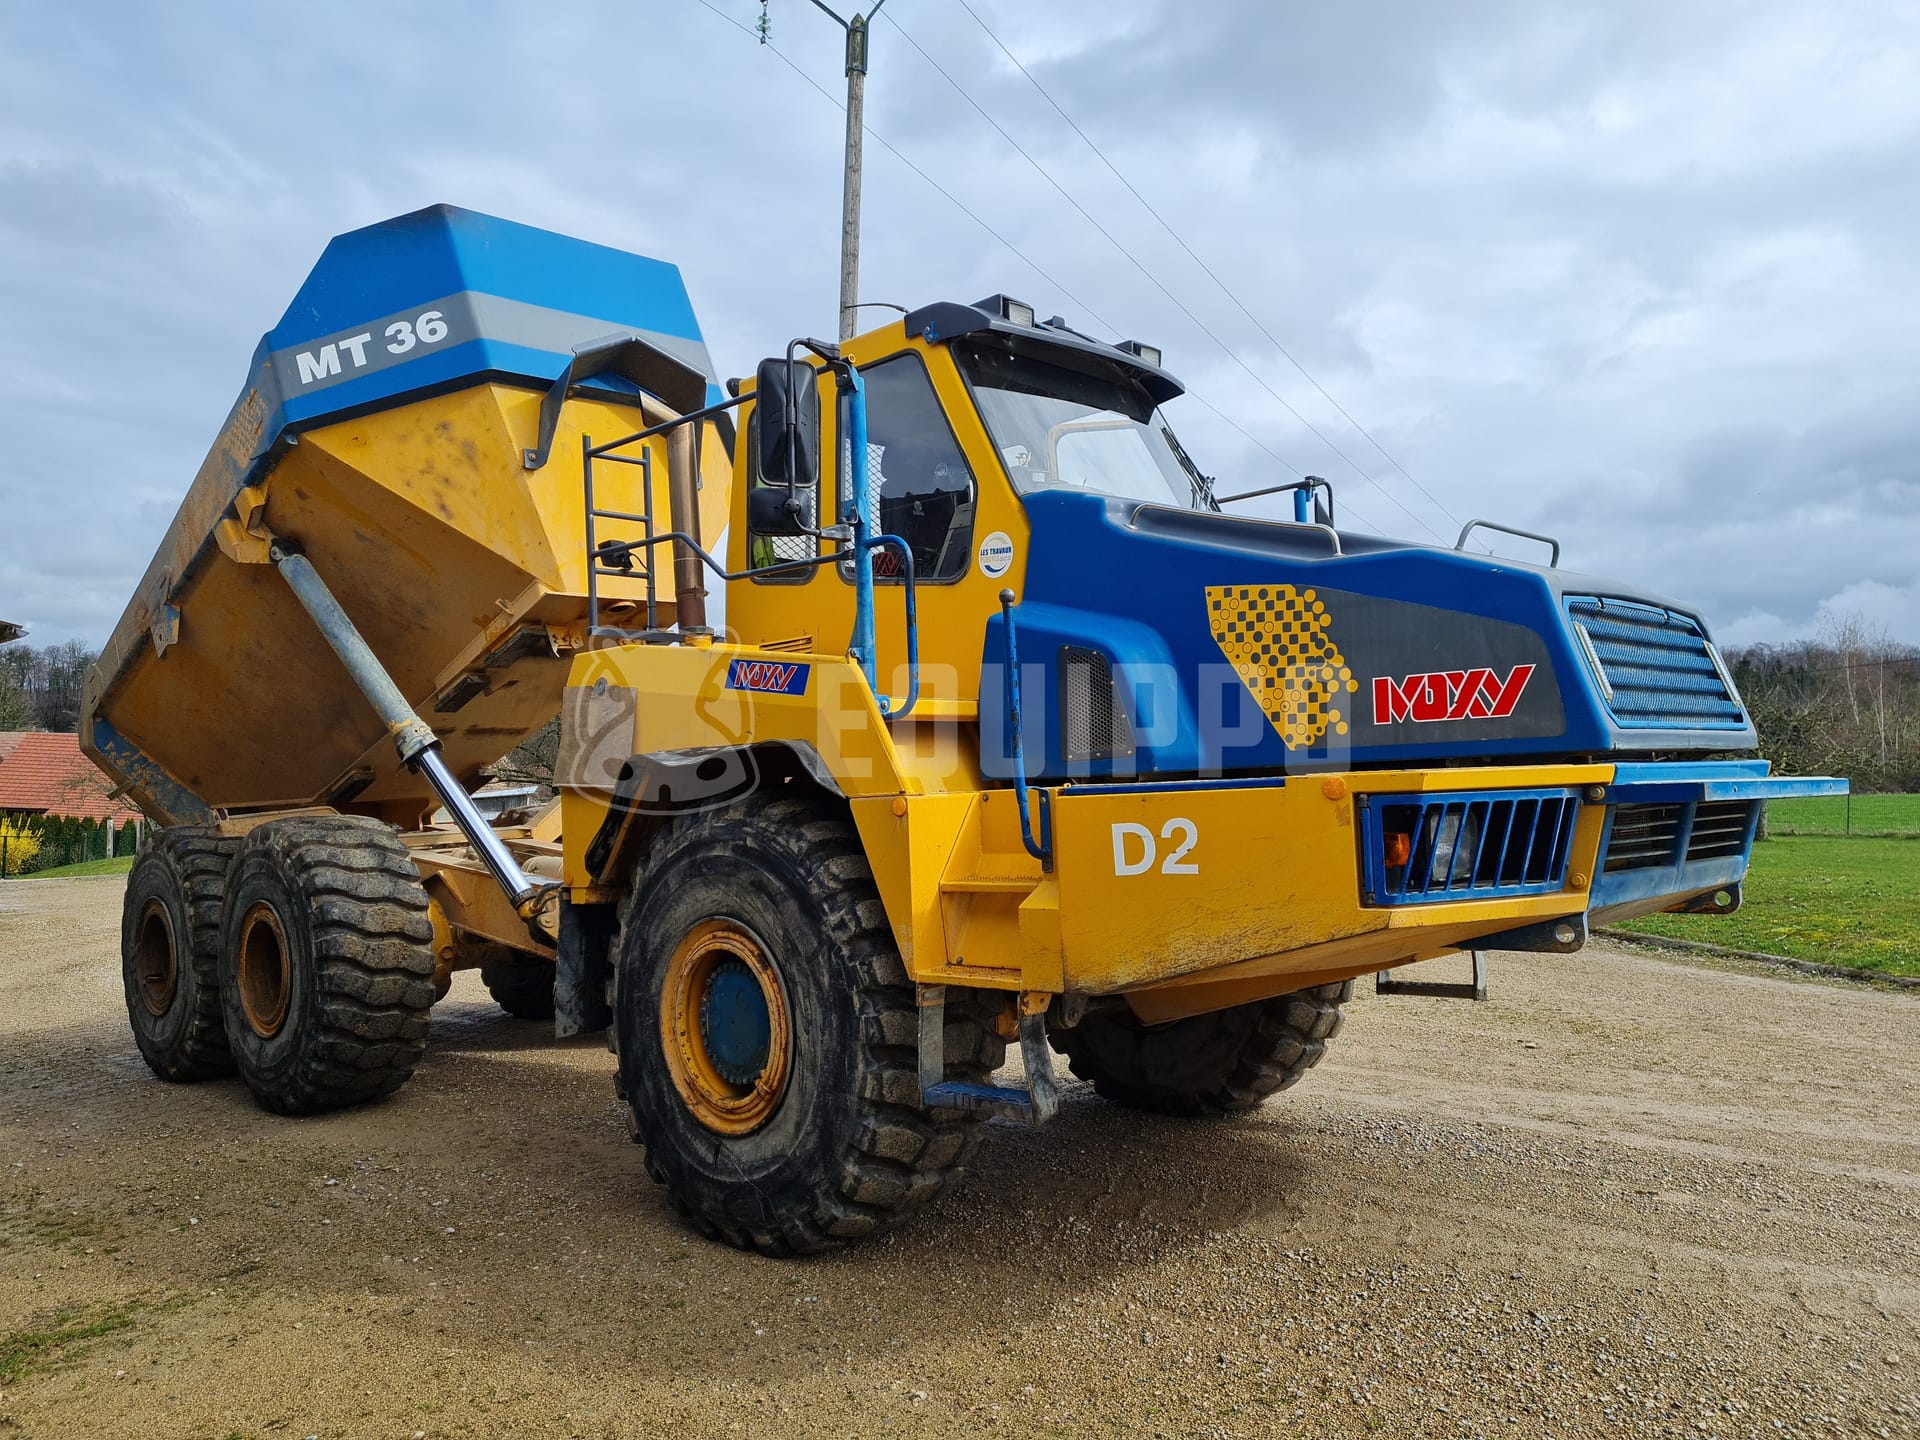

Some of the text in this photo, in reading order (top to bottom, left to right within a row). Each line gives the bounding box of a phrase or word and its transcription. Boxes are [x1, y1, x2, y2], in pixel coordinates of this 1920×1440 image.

[296, 310, 449, 385] MT 36
[980, 548, 989, 556] LES
[733, 662, 798, 691] MOXY
[1372, 663, 1537, 725] MOXY
[1111, 817, 1199, 877] D2
